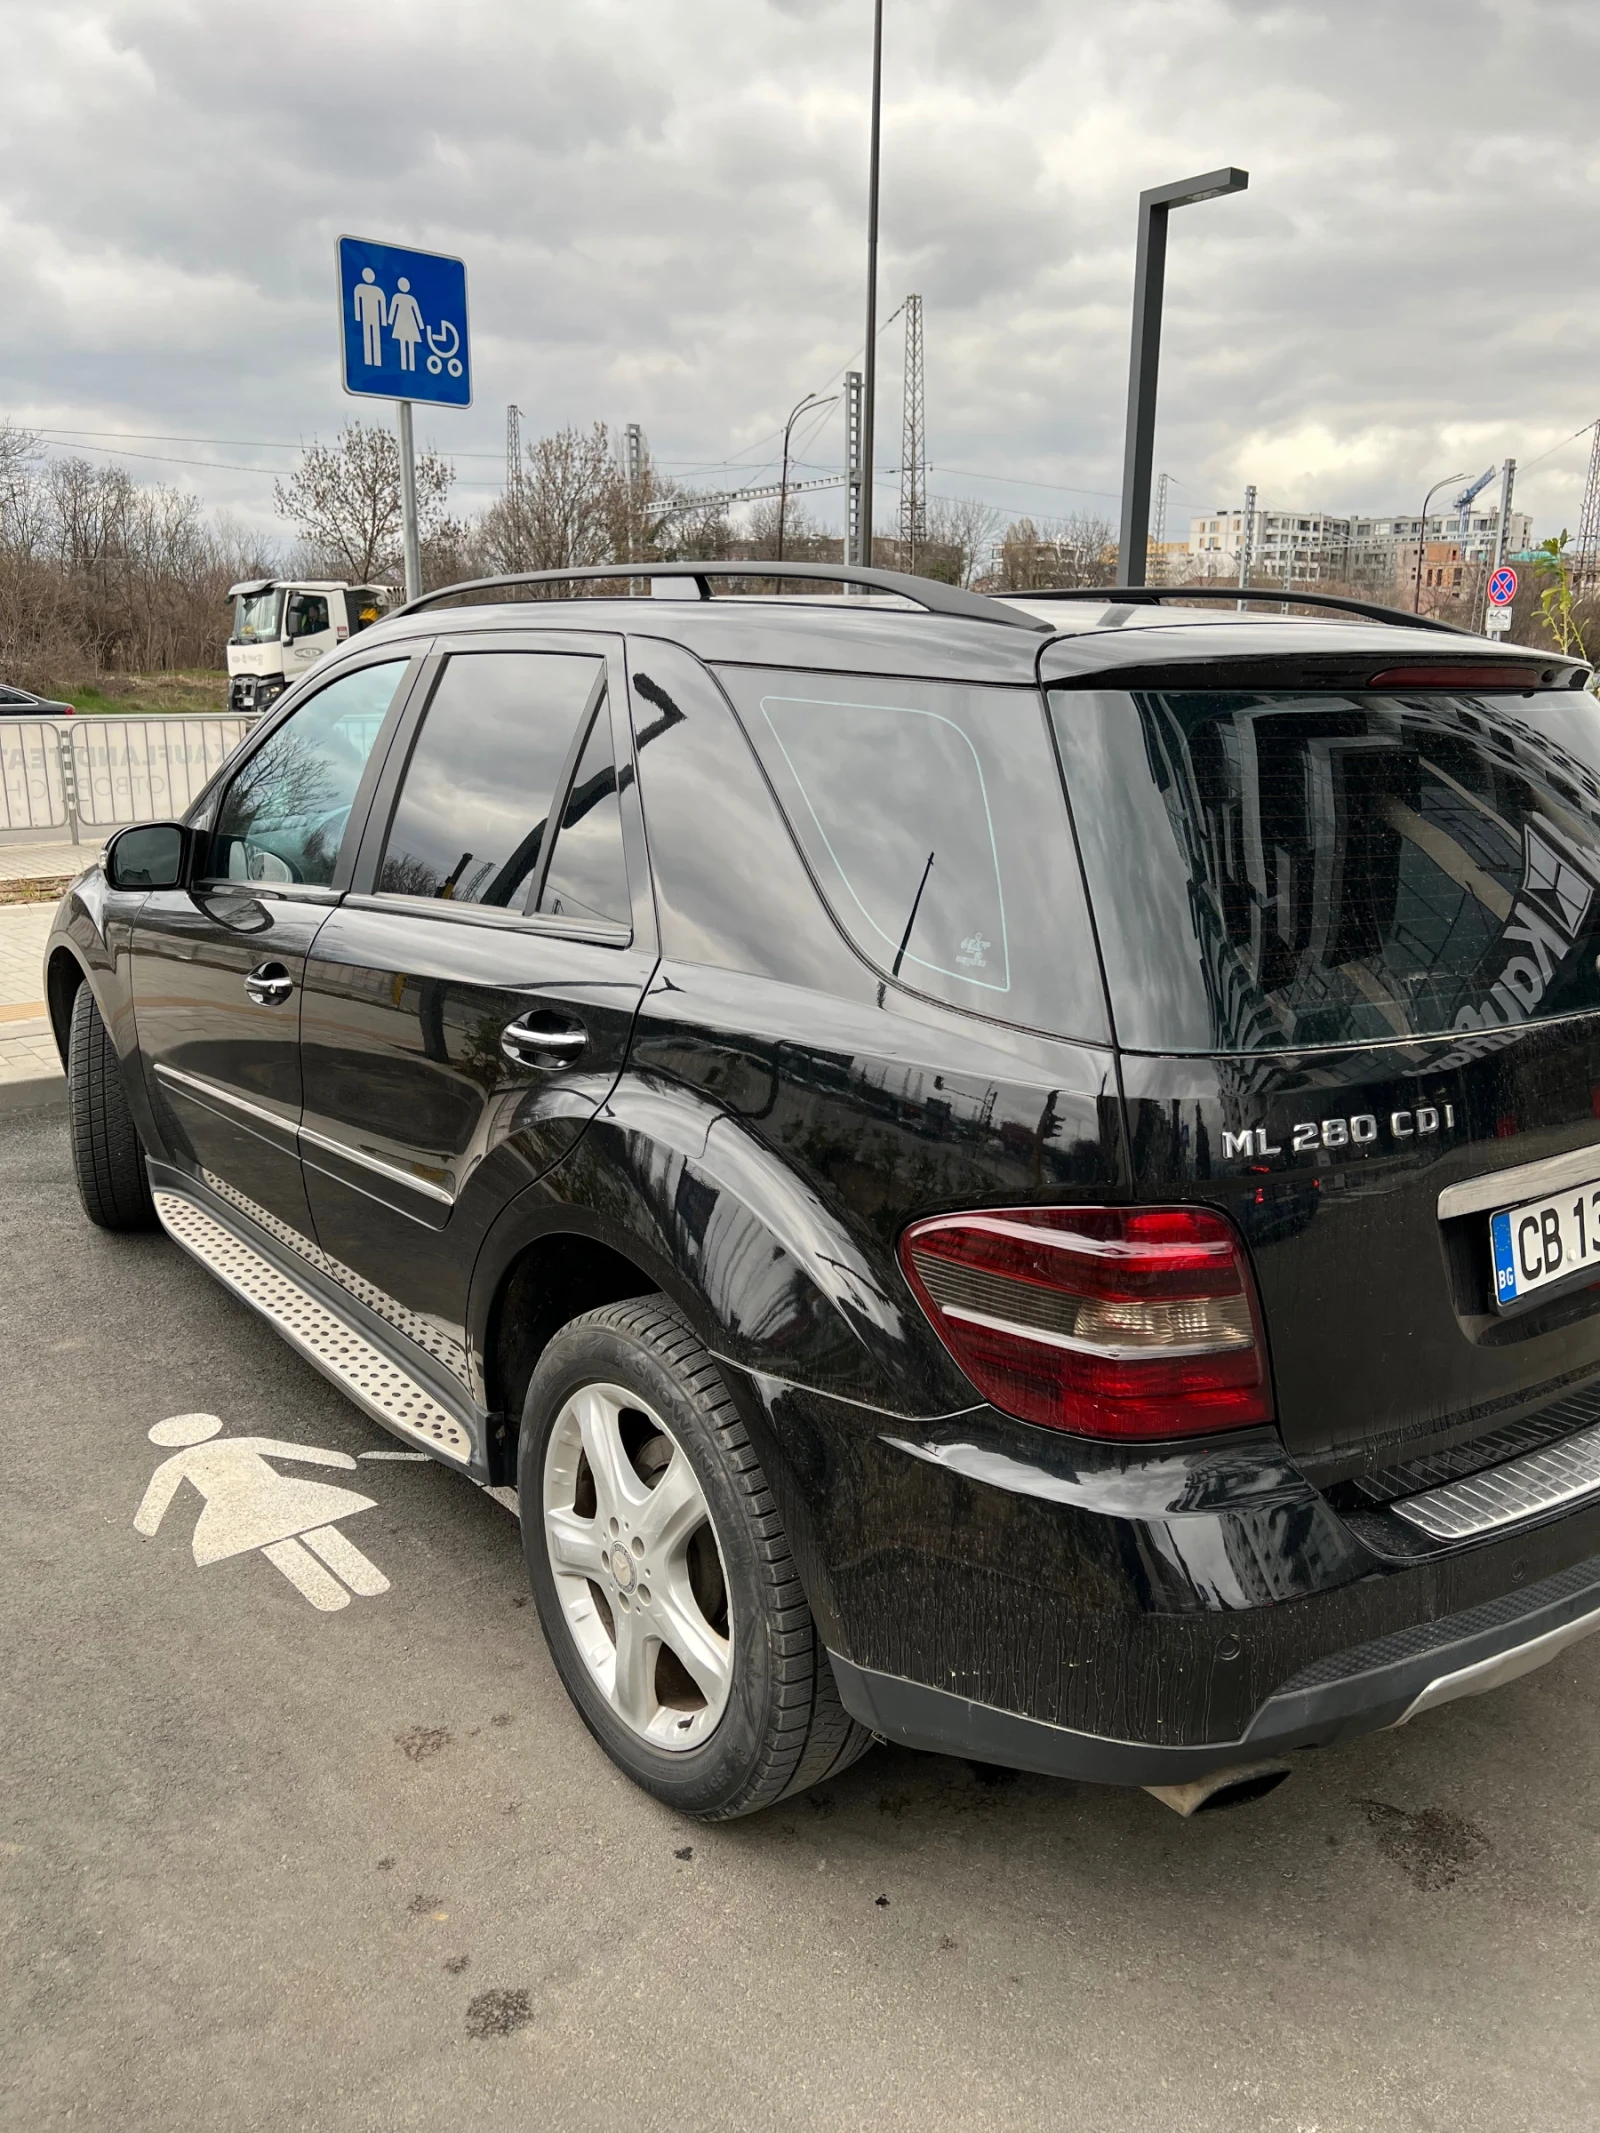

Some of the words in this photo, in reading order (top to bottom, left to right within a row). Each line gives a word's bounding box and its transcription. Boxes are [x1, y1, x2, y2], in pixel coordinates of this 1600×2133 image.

[1221, 1128, 1281, 1159] ML
[1293, 1114, 1377, 1152] 280
[1390, 1104, 1455, 1137] CDI
[1498, 1267, 1514, 1290] BG
